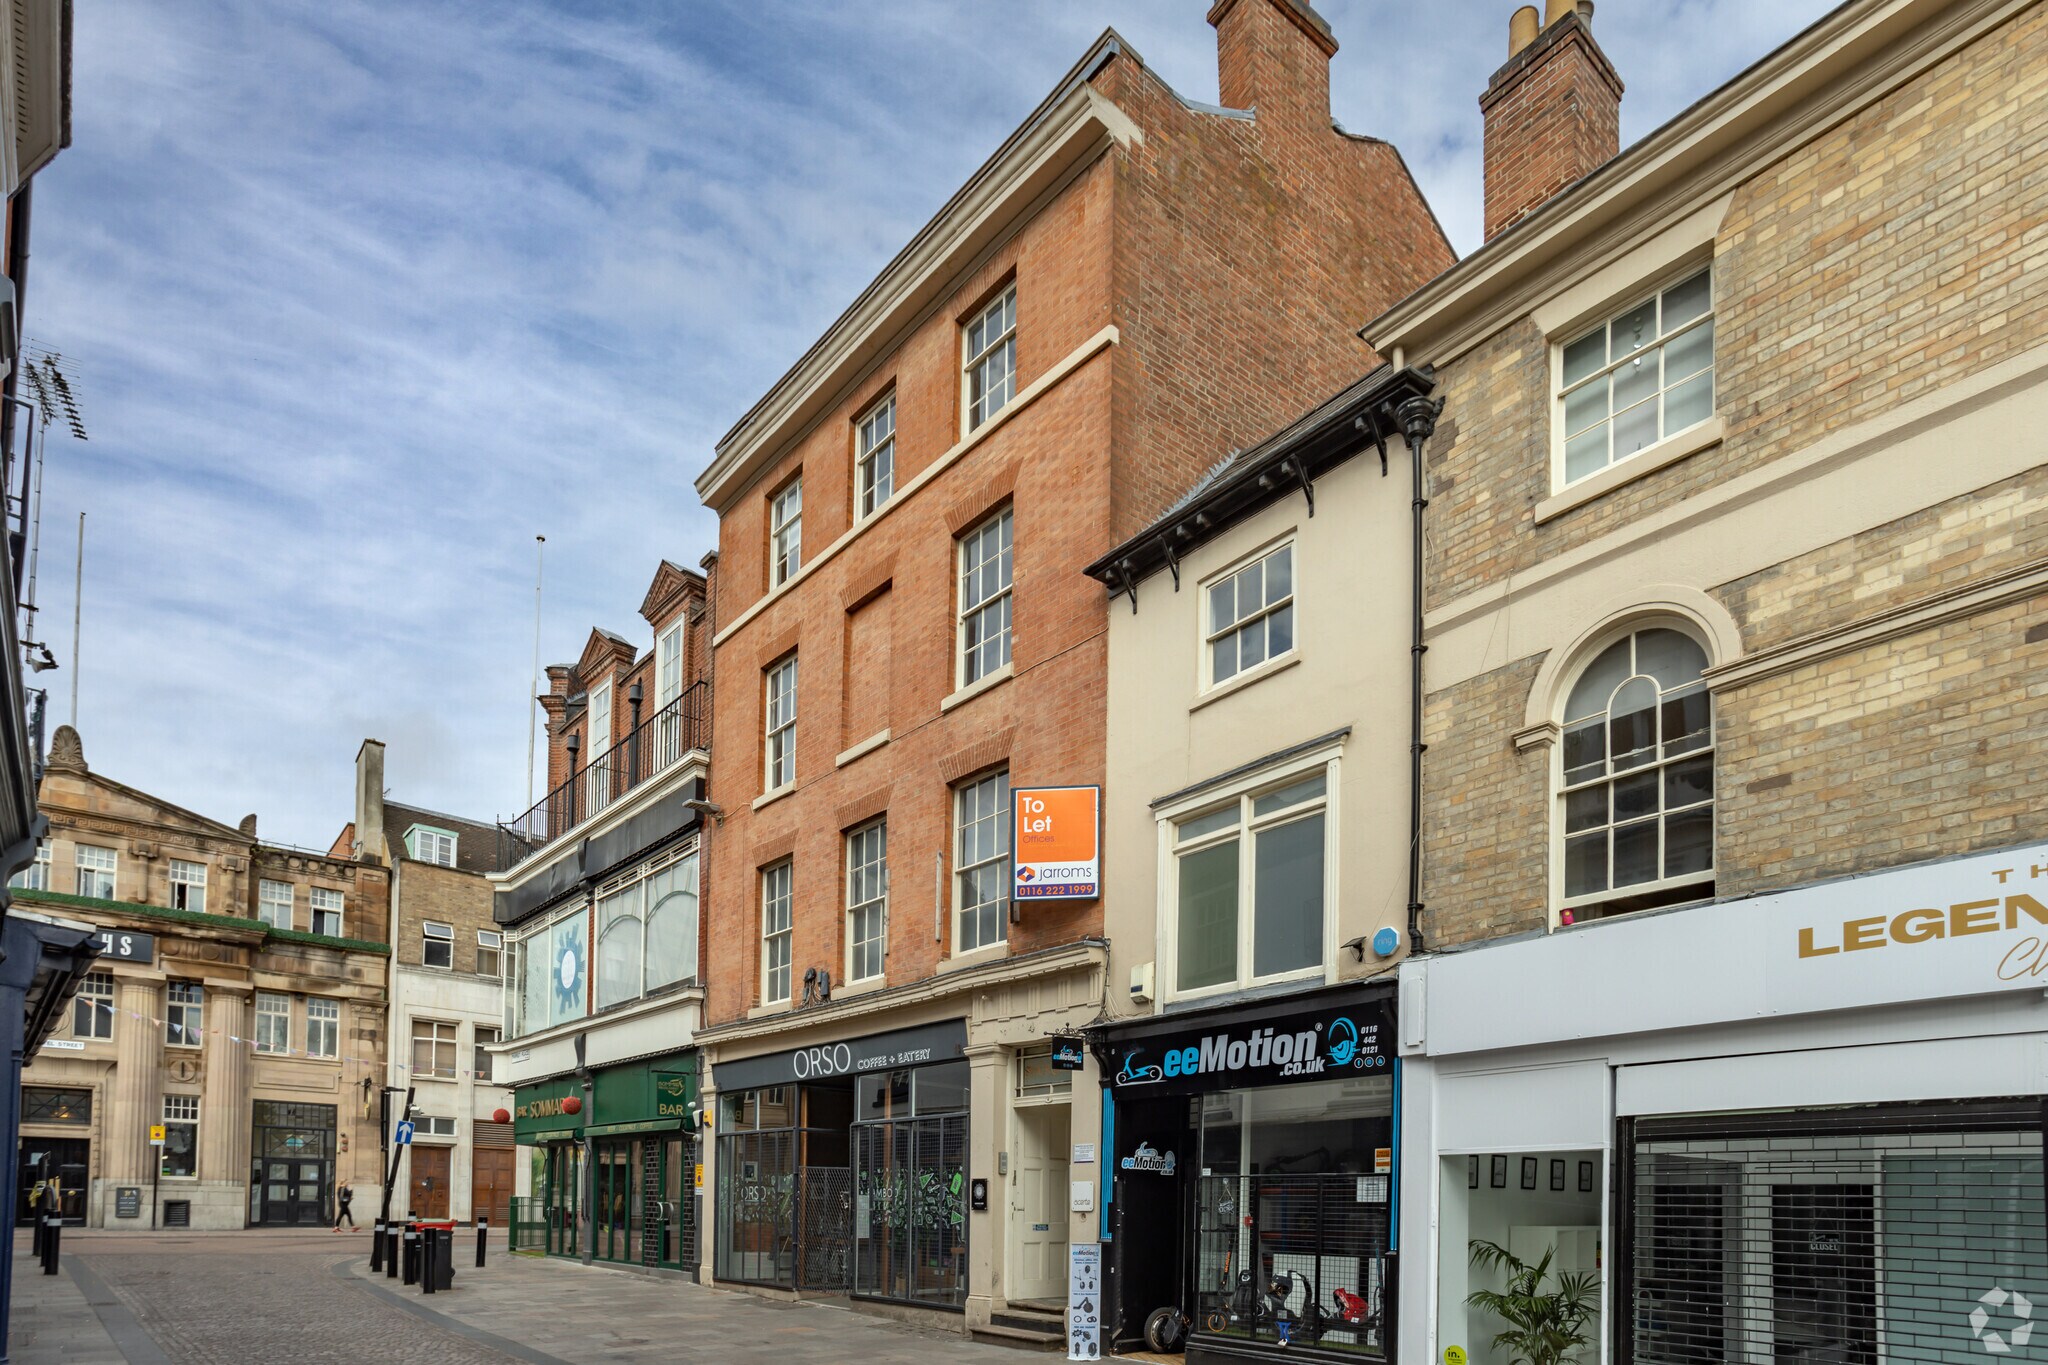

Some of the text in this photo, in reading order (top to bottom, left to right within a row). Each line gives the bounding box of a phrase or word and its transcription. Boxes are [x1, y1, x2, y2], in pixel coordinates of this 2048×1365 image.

[1022, 797, 1045, 814] To
[1023, 815, 1053, 833] Let
[1022, 834, 1055, 844] Offices
[1038, 866, 1092, 881] jarroms
[1019, 884, 1093, 896] 0116 222 1999
[1360, 1024, 1378, 1035] 0116
[1363, 1035, 1377, 1044] 442
[1163, 1027, 1318, 1077] eeMotion
[1361, 1045, 1378, 1055] 0121
[793, 1042, 851, 1079] ORSO
[857, 1055, 888, 1071] COFFEE
[897, 1048, 931, 1064] EATERY
[1279, 1055, 1326, 1077] .co.uk
[530, 1097, 568, 1118] SOMMAR
[659, 1103, 684, 1116] BAR
[1122, 1157, 1166, 1170] eeMotion
